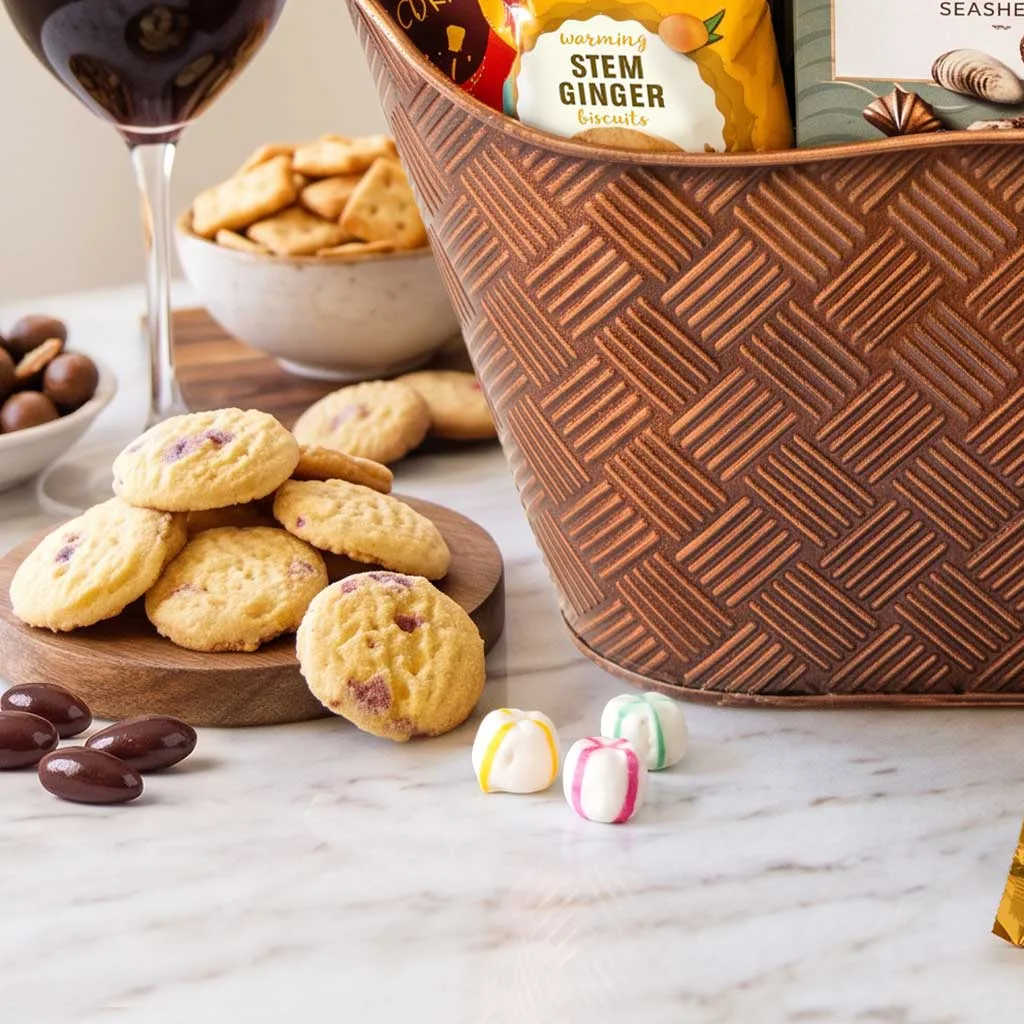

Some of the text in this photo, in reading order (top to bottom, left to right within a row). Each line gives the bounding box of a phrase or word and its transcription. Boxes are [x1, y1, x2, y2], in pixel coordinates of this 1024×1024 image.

[560, 31, 648, 53] warming
[570, 54, 644, 80] STEM
[558, 81, 666, 108] GINGER
[577, 109, 649, 127] biscuits
